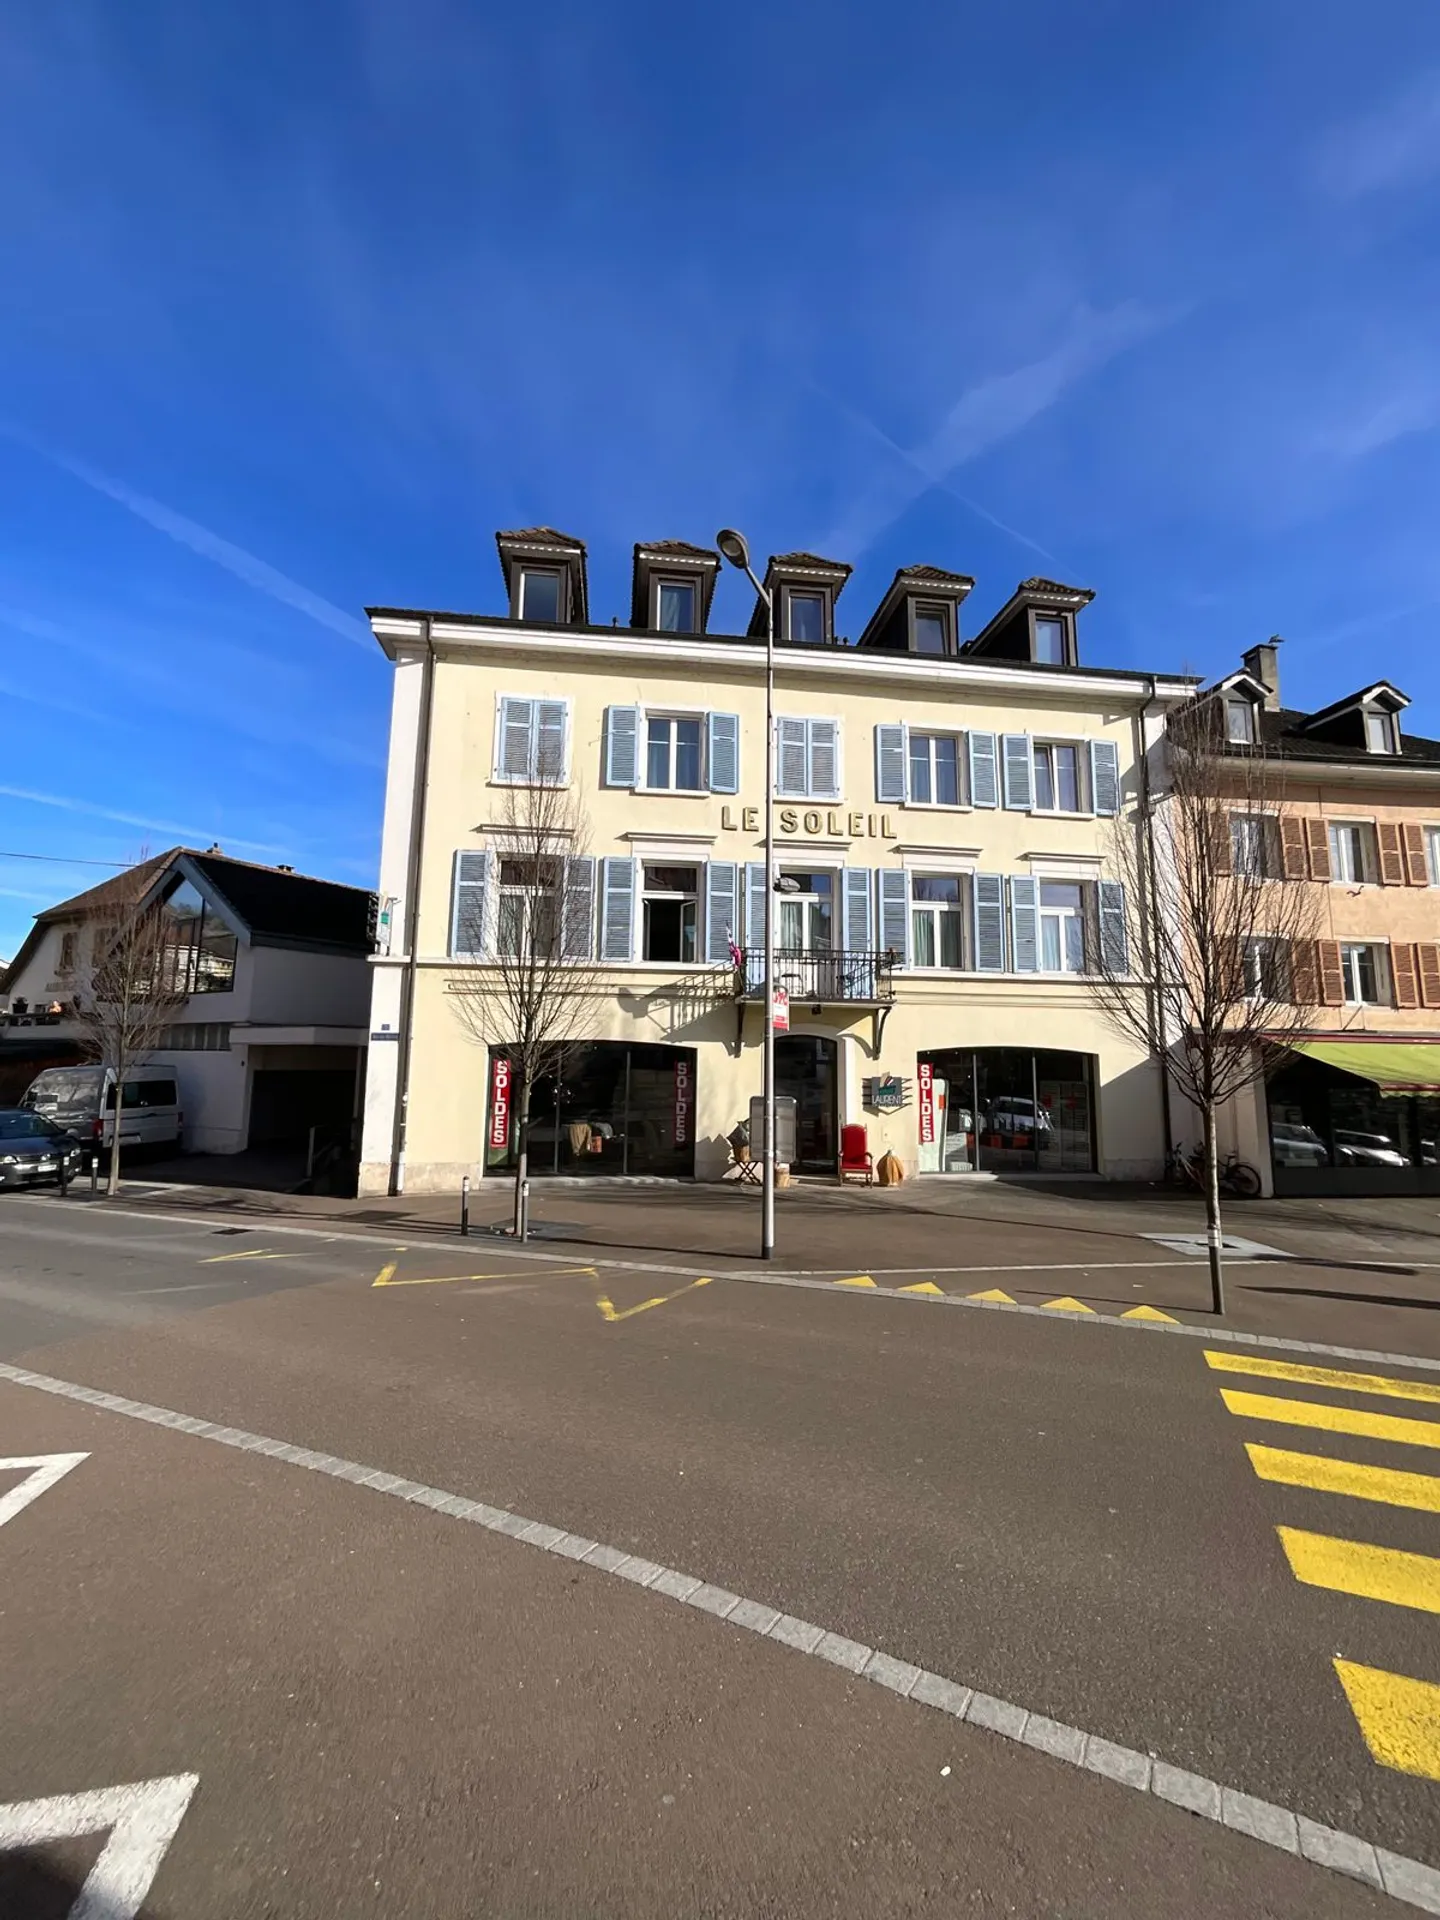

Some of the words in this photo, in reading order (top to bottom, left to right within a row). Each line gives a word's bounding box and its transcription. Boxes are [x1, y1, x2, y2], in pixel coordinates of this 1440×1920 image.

[721, 805, 759, 832] LE
[780, 808, 897, 839] SOLEIL
[493, 1060, 508, 1143] SOLDES
[675, 1062, 688, 1142] SOLDES
[872, 1094, 902, 1104] LAURENT
[920, 1064, 932, 1142] SOLDES
